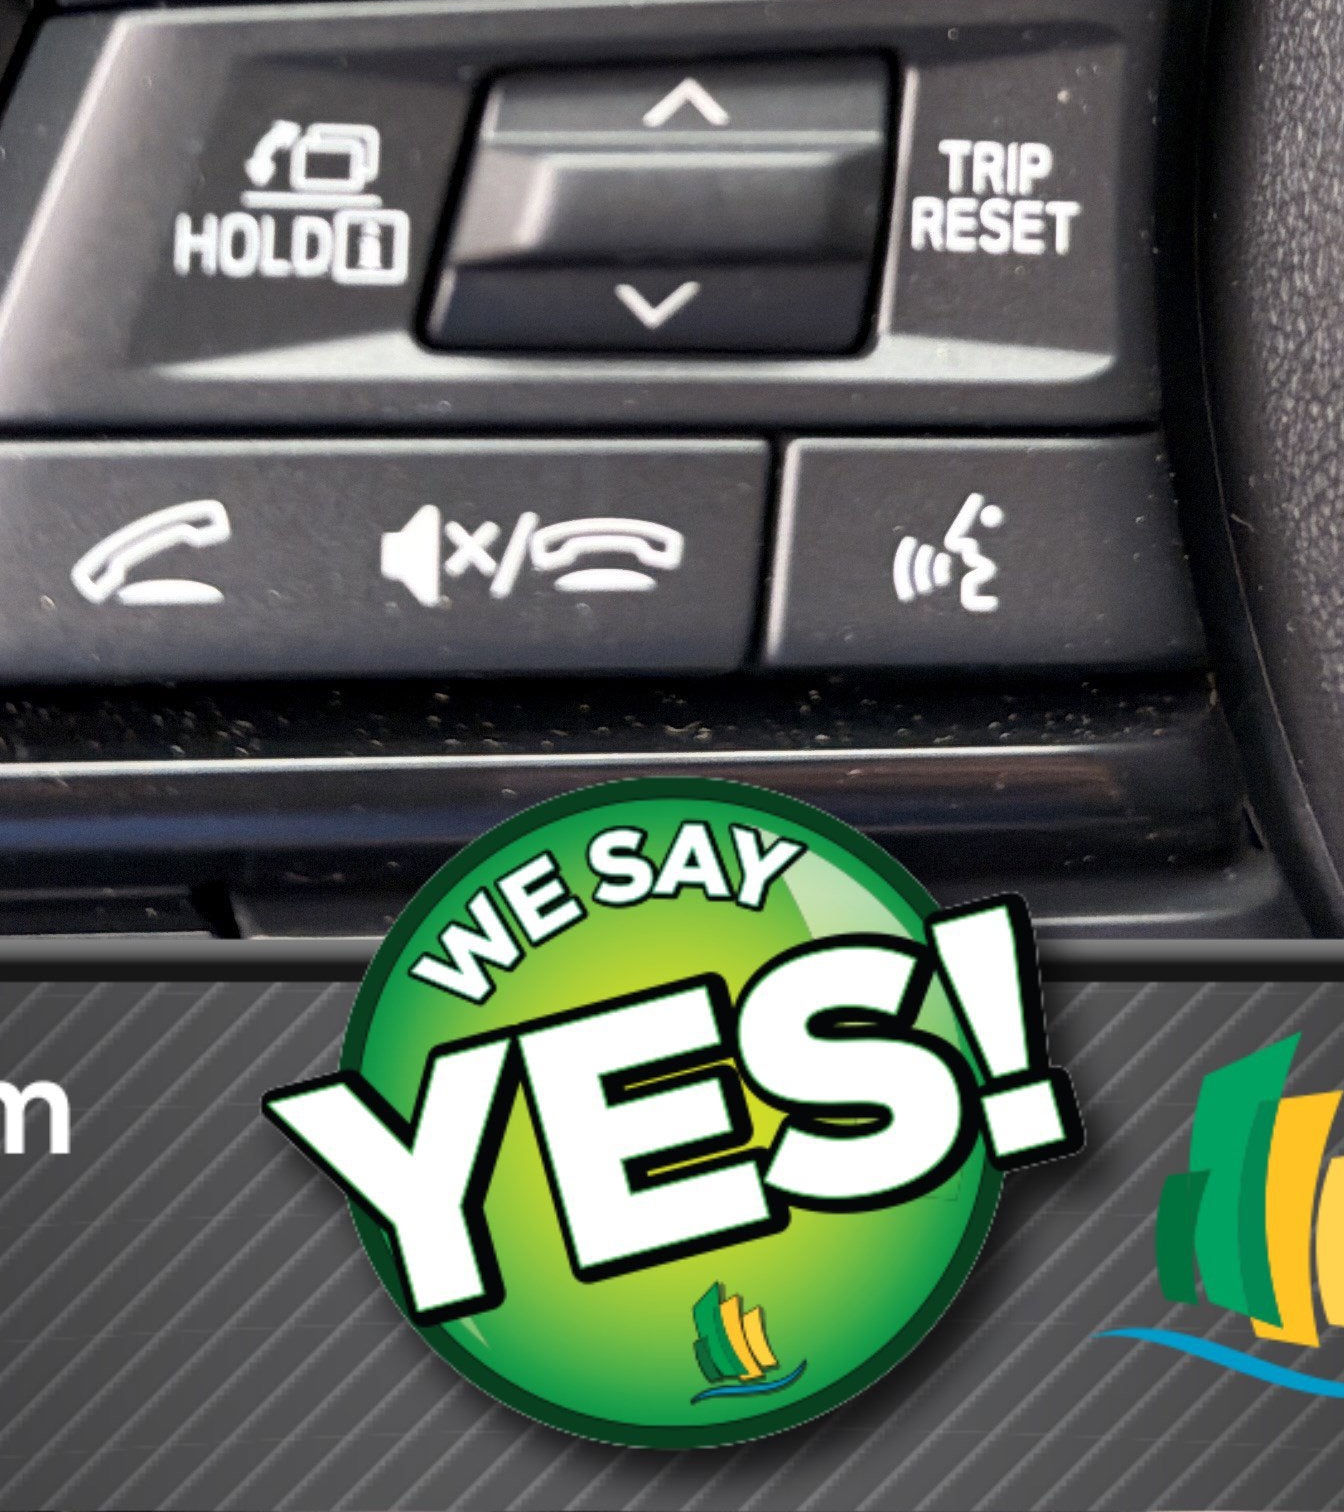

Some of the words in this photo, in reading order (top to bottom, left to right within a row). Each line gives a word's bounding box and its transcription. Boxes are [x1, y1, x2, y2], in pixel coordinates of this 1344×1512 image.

[938, 138, 1054, 196] TRIP
[173, 211, 333, 278] HOLD
[910, 196, 1081, 256] RESET
